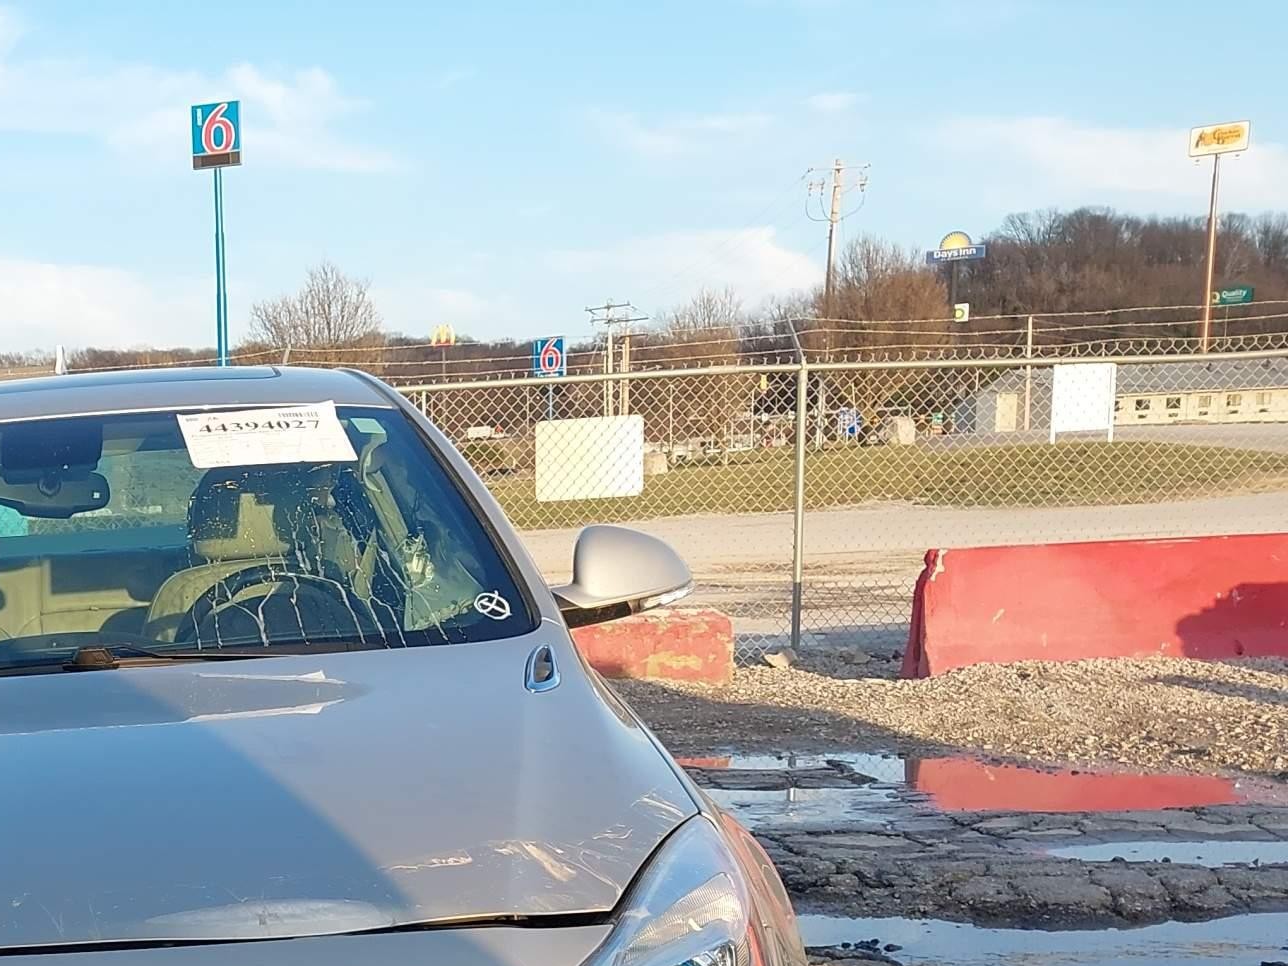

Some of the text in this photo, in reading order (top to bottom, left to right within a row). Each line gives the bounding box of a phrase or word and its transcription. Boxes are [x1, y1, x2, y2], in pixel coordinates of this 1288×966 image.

[202, 103, 235, 154] 6
[933, 248, 958, 260] Days
[959, 246, 977, 258] Inn
[540, 337, 561, 372] 6
[199, 419, 320, 434] 44394027
